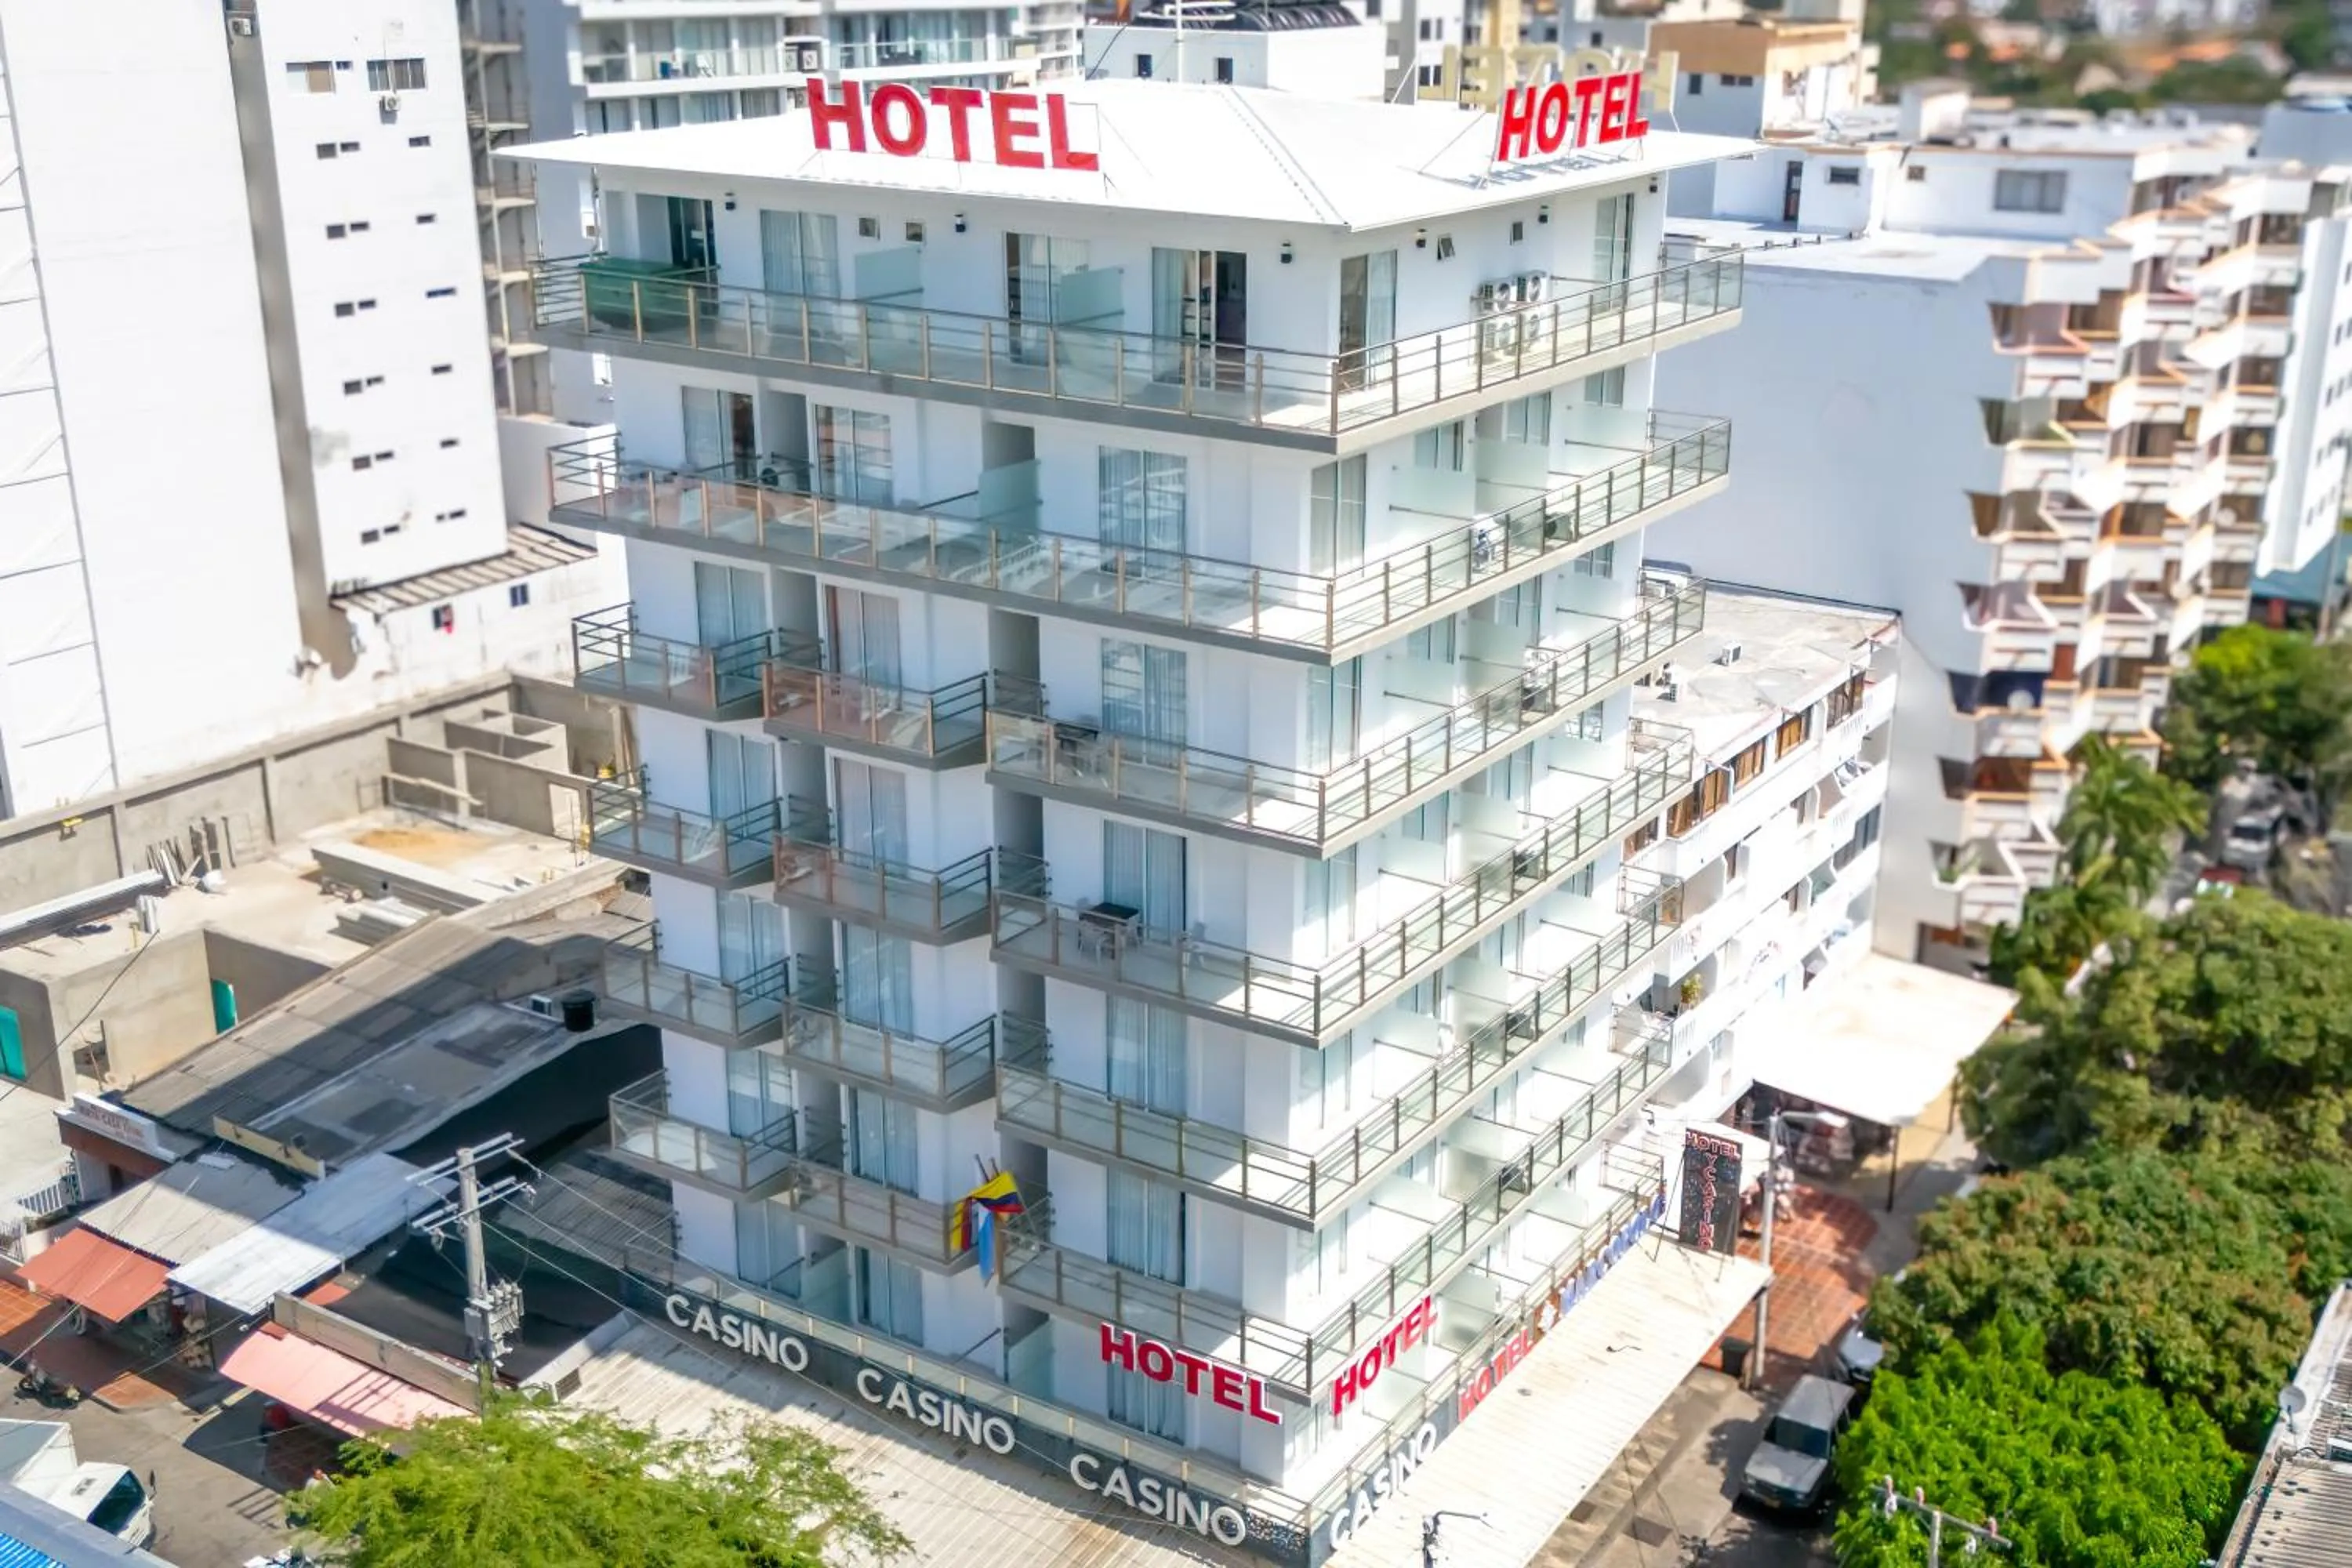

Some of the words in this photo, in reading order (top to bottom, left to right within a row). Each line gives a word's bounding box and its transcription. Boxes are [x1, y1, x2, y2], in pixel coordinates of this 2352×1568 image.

[806, 78, 1099, 171] HOTEL
[1497, 71, 1650, 162] HOTEL
[1686, 1131, 1741, 1160] HOTEL
[1697, 1166, 1716, 1252] CASINO
[666, 1294, 808, 1372] CASINO
[1100, 1321, 1283, 1425] HOTEL
[1330, 1294, 1438, 1417] HOTEL
[1459, 1328, 1534, 1422] HOTEL
[857, 1369, 1015, 1454] CASINO
[1070, 1454, 1246, 1546] CASINO
[1330, 1422, 1436, 1549] CASINO
